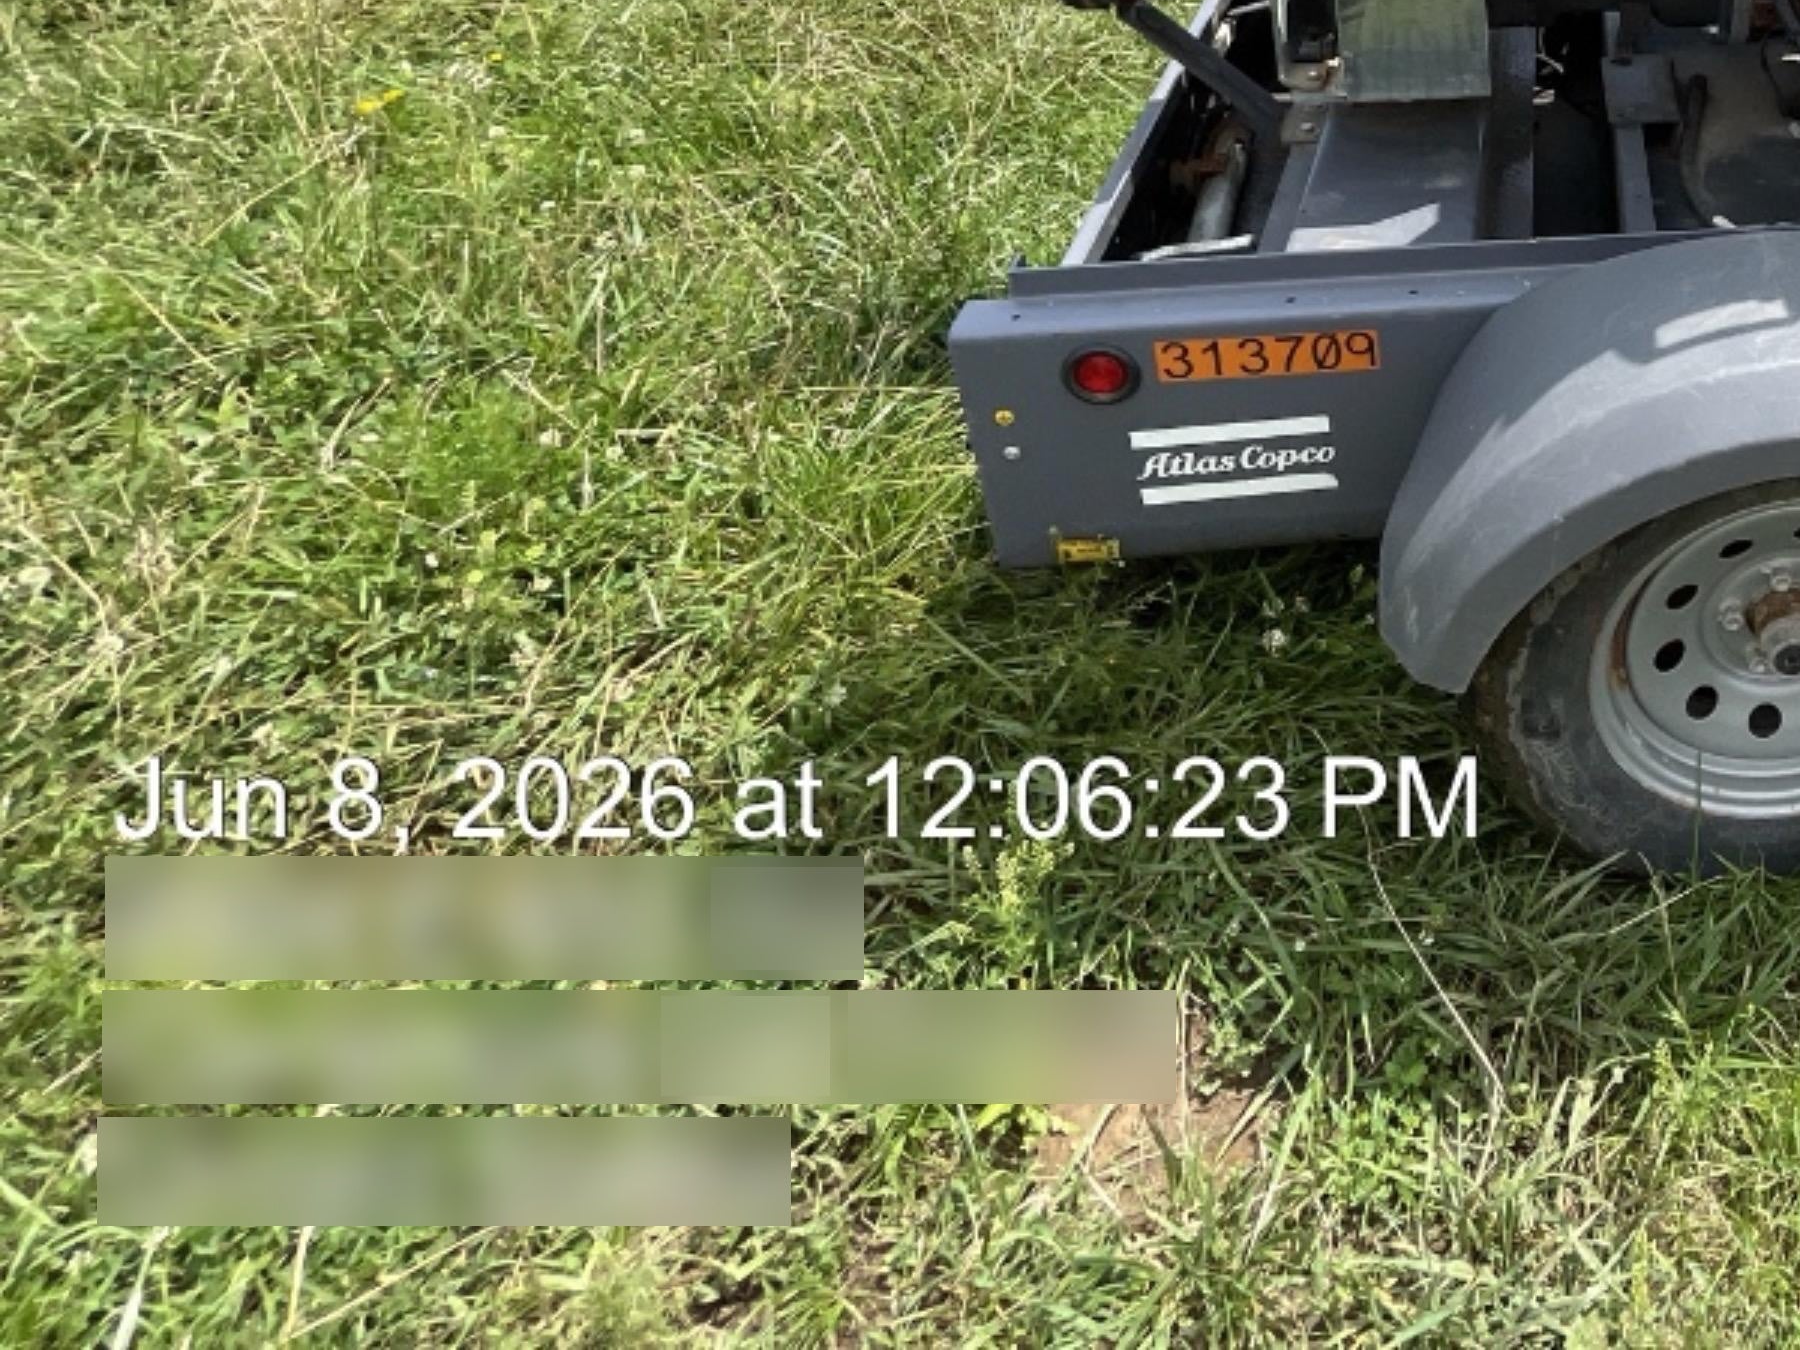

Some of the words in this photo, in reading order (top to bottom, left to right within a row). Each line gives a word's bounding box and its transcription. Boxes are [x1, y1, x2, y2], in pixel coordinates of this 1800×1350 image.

[1160, 331, 1378, 379] 313709
[1137, 451, 1236, 480] Atlas
[1239, 443, 1337, 472] Copco
